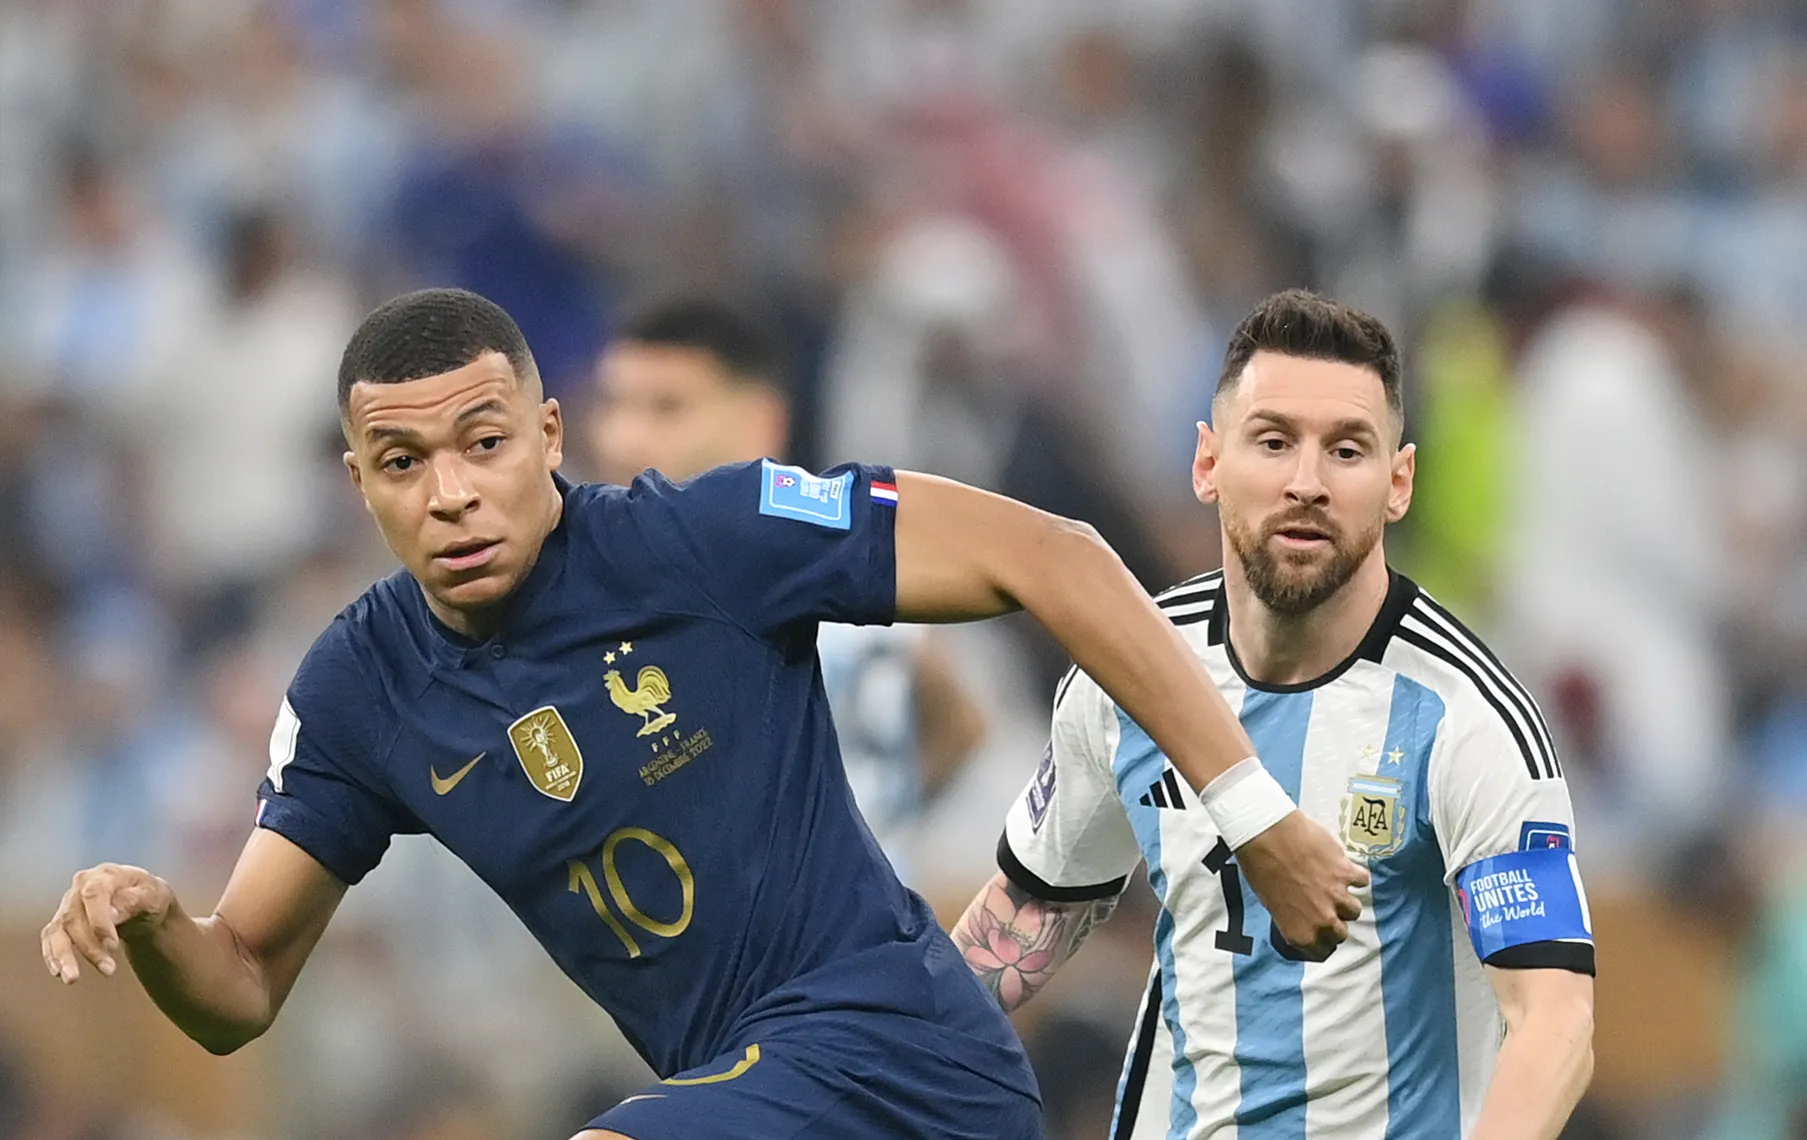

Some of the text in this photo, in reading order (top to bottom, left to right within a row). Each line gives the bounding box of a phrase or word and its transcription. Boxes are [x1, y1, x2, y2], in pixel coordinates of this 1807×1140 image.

[545, 764, 570, 782] FIFA
[1353, 796, 1388, 836] AFA
[566, 827, 694, 958] 10
[1470, 868, 1532, 894] FOOTBALL
[1201, 835, 1338, 963] 1
[1474, 882, 1538, 912] UNITES
[1480, 901, 1546, 929] the World
